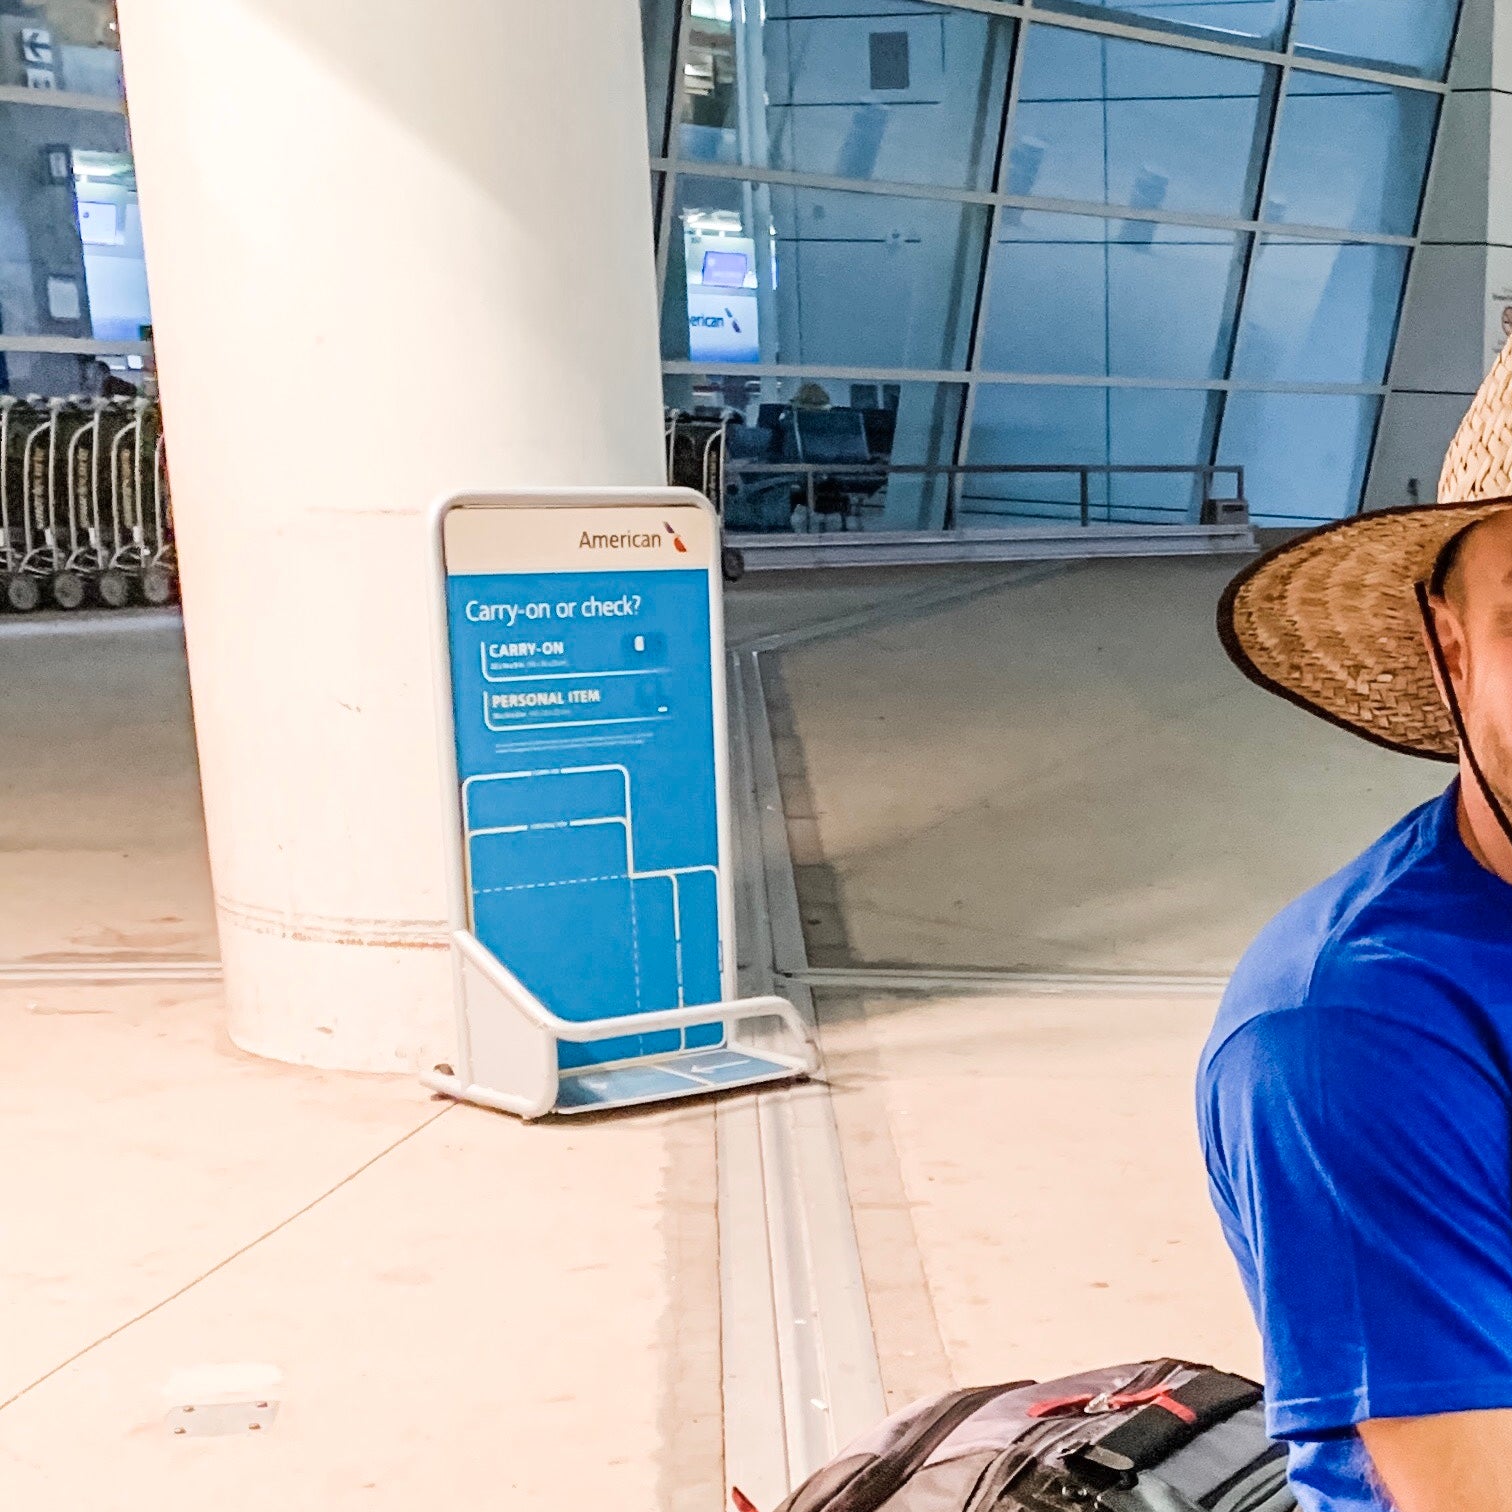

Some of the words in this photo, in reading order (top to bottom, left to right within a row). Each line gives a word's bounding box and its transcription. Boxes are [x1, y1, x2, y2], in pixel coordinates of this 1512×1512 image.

[690, 313, 724, 327] erican
[579, 530, 662, 549] American
[465, 600, 551, 627] Carry-on
[556, 601, 576, 618] or
[581, 595, 642, 617] check?
[489, 641, 564, 658] CARRY-ON
[491, 691, 565, 709] PERSONAL
[568, 689, 601, 703] ITEM
